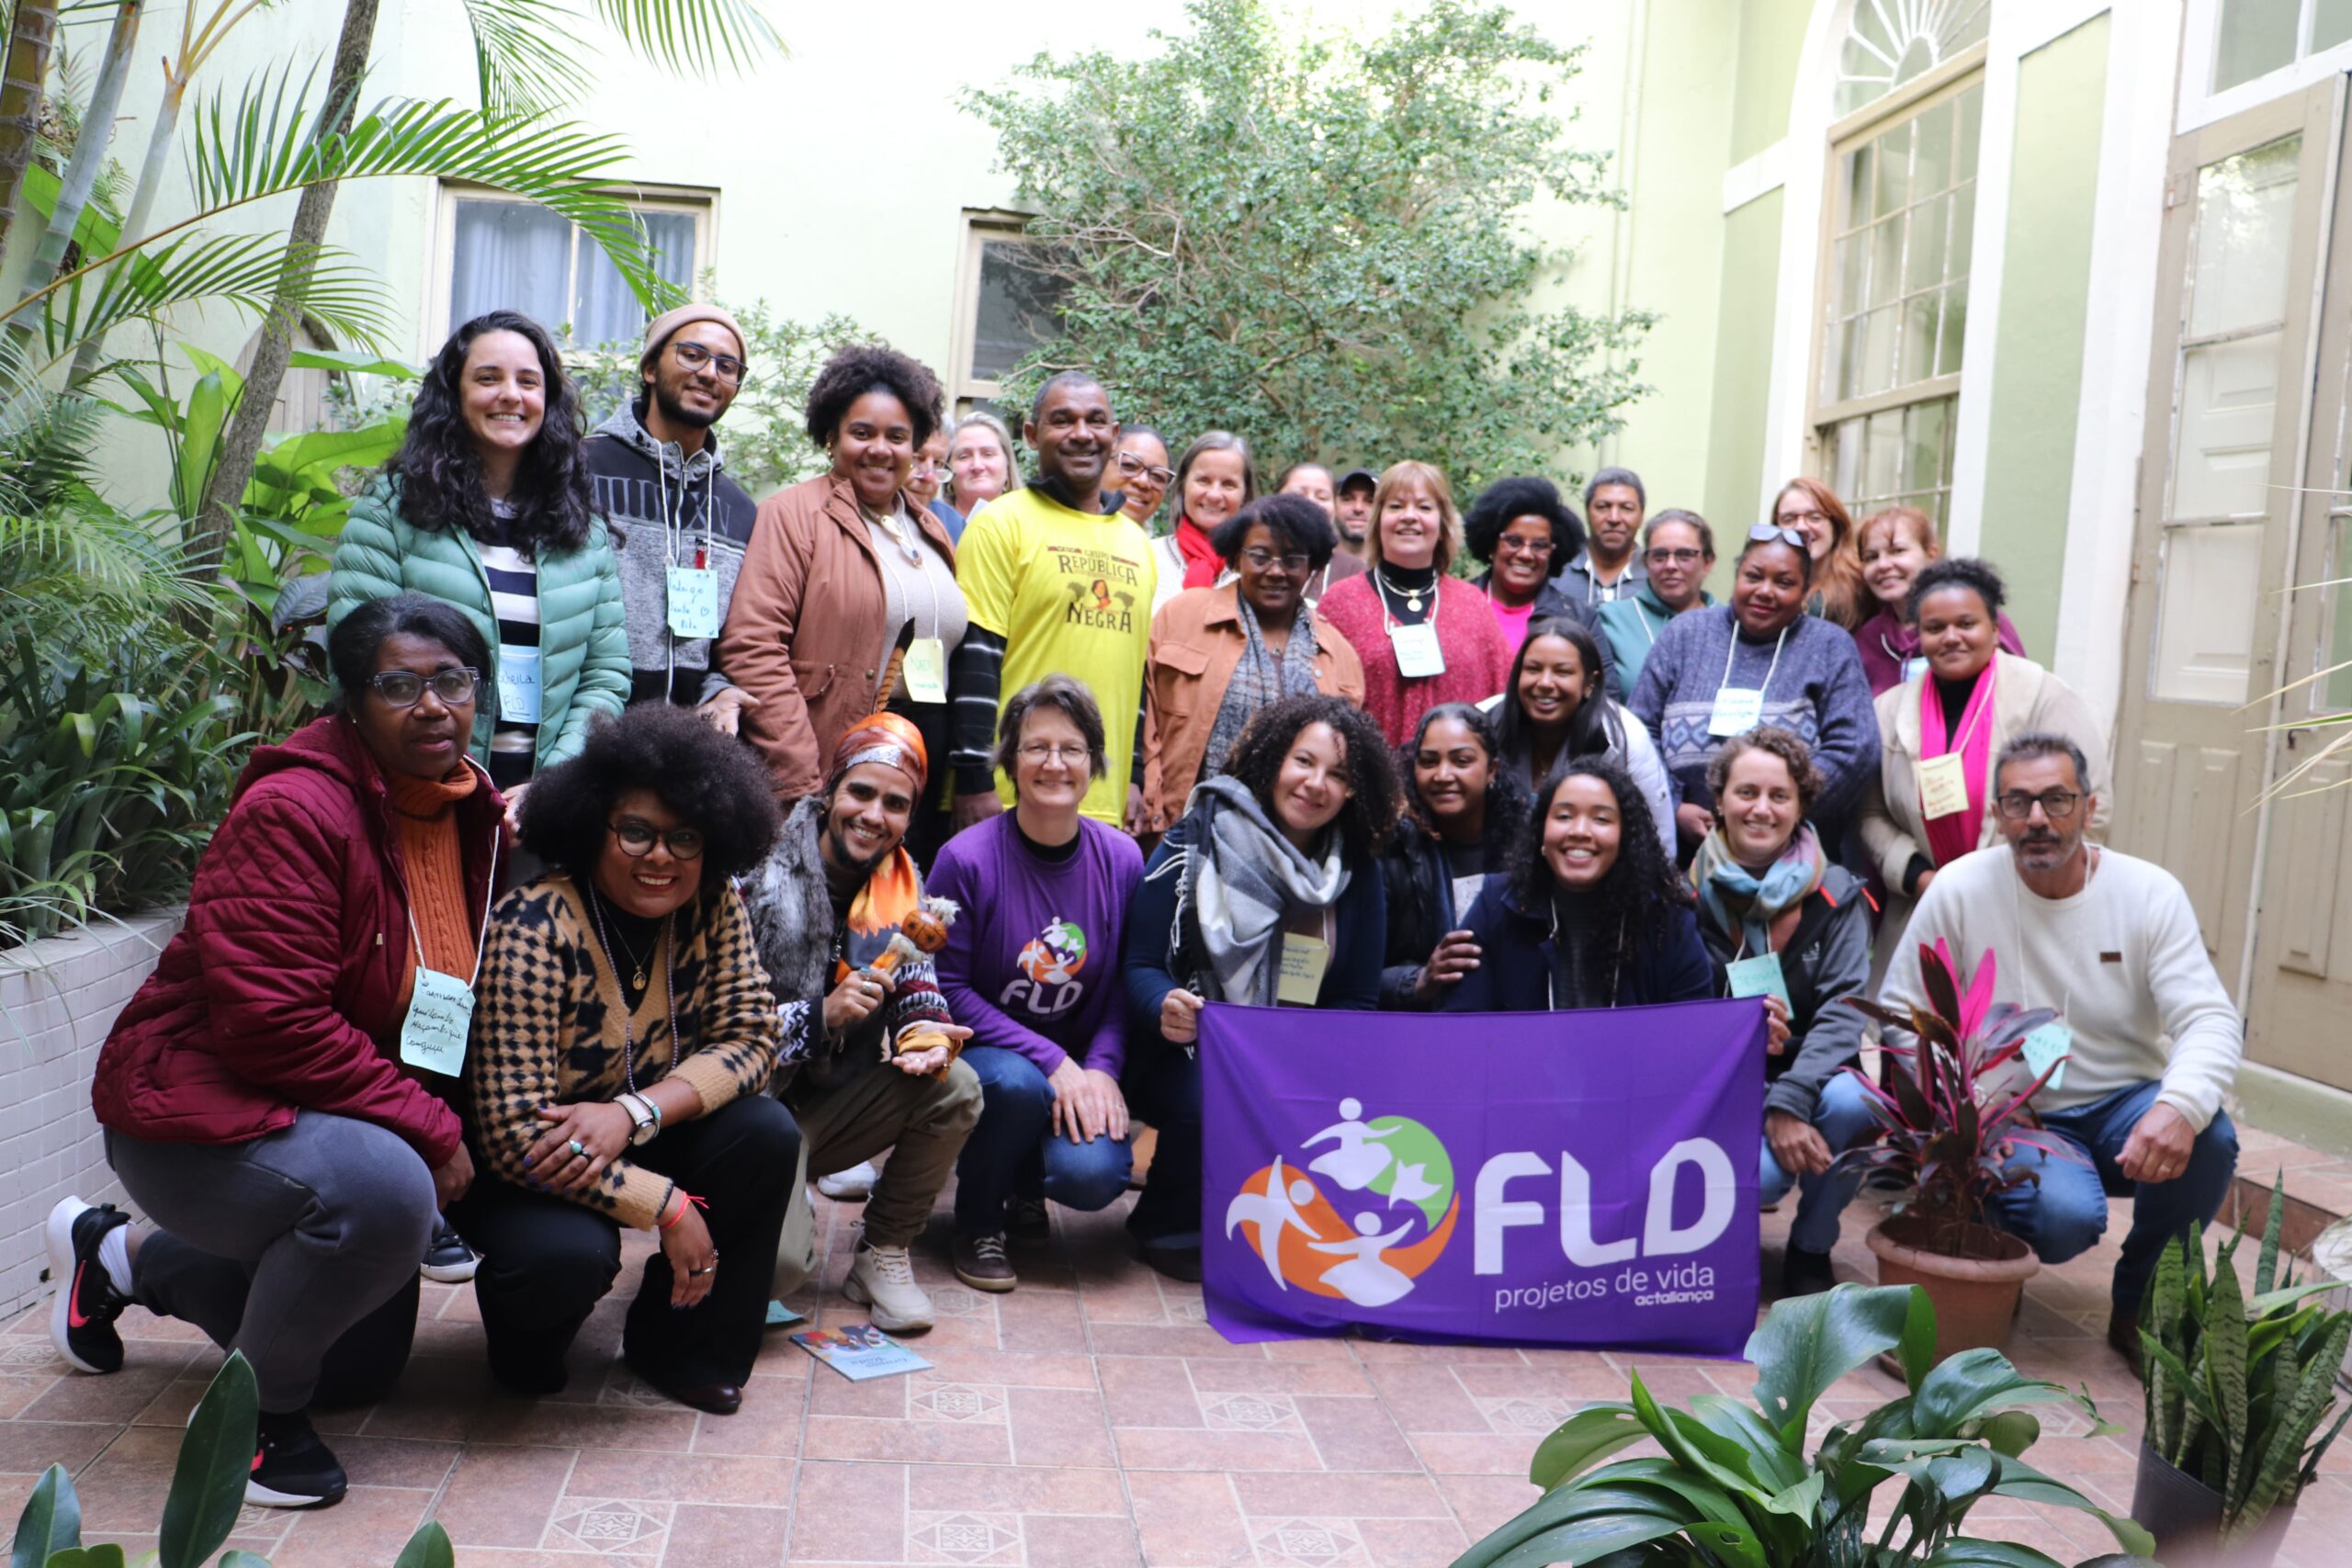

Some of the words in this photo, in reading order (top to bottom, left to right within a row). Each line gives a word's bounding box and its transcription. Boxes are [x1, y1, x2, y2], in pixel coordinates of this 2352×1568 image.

[1066, 601, 1131, 634] NEGRA
[1000, 979, 1083, 1014] FLD
[1475, 1137, 1736, 1275] FLD
[1495, 1277, 1607, 1314] projetos
[1614, 1267, 1648, 1293] de
[1656, 1261, 1714, 1289] vida
